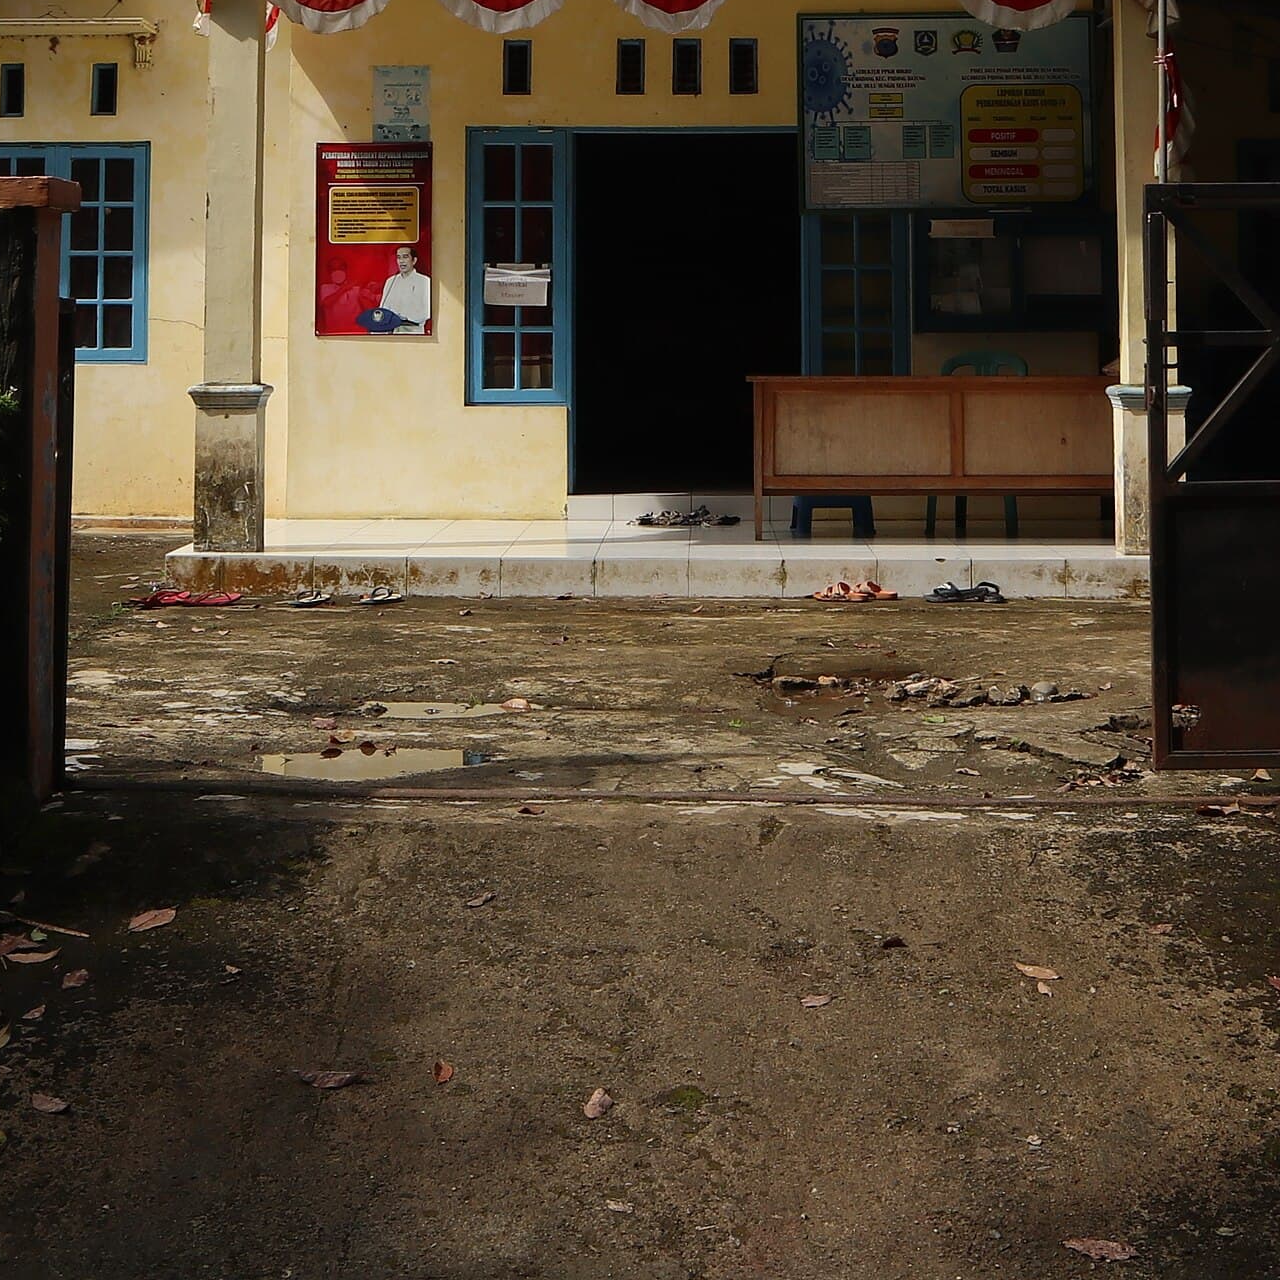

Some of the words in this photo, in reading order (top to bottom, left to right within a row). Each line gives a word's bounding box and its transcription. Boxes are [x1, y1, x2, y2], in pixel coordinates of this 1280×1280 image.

[990, 132, 1017, 140] POSITIF
[990, 150, 1018, 158] SEMBUH
[983, 185, 1004, 193] TOTAL
[1005, 185, 1026, 193] KASUS
